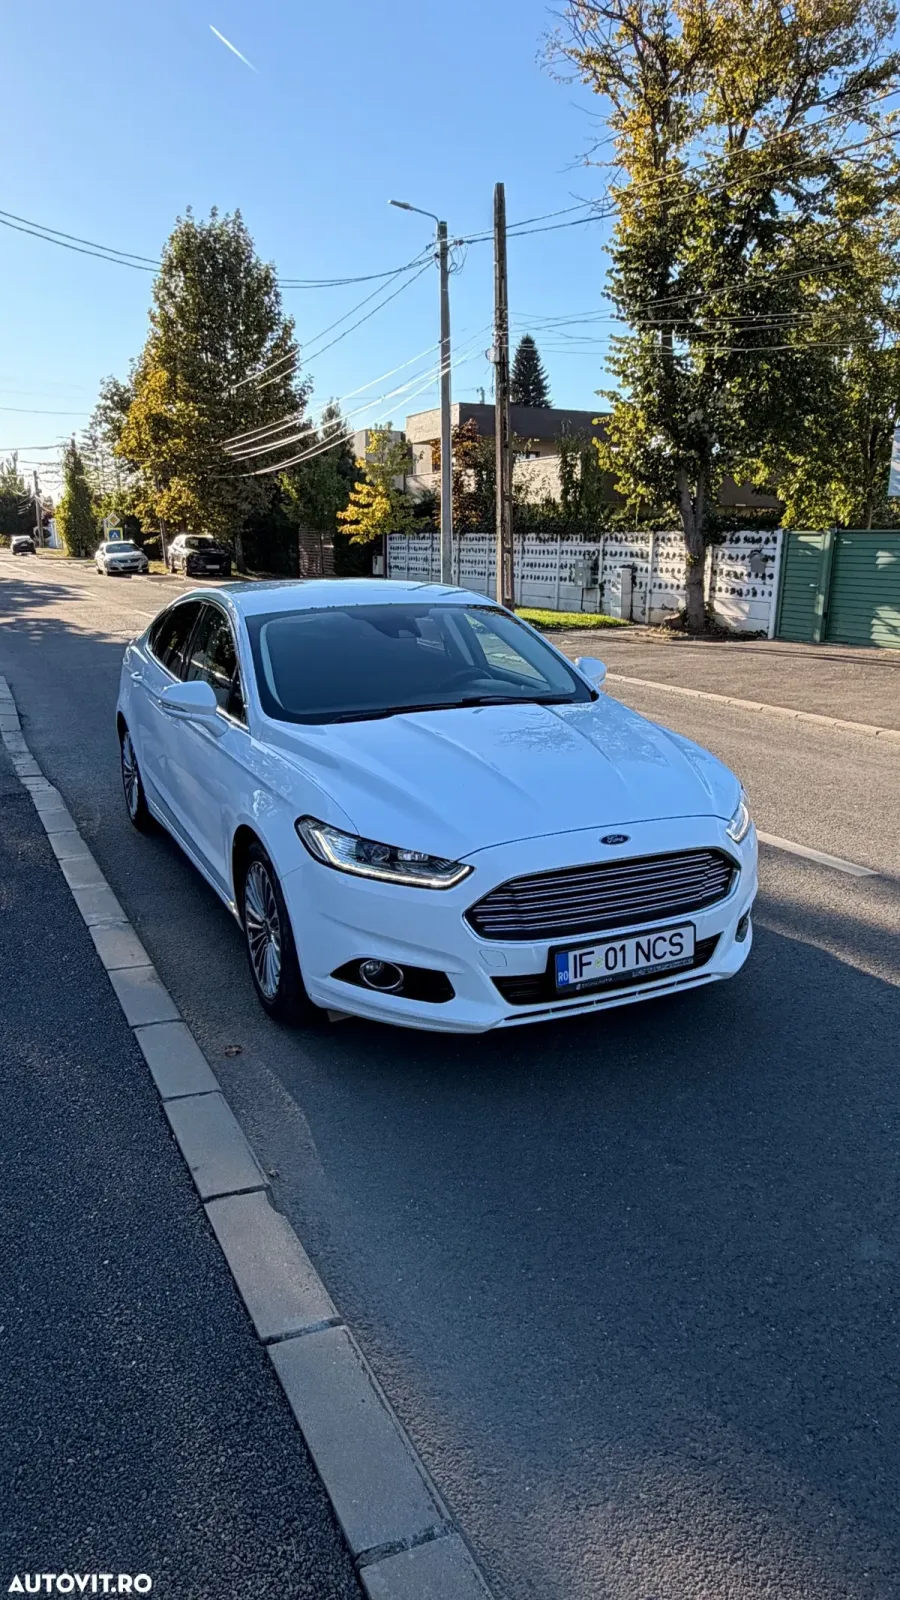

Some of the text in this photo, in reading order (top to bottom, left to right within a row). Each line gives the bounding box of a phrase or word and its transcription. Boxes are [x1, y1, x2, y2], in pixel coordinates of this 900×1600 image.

[573, 951, 595, 979] IF
[604, 944, 626, 970] 01
[635, 932, 684, 965] NCS
[558, 971, 568, 982] RO
